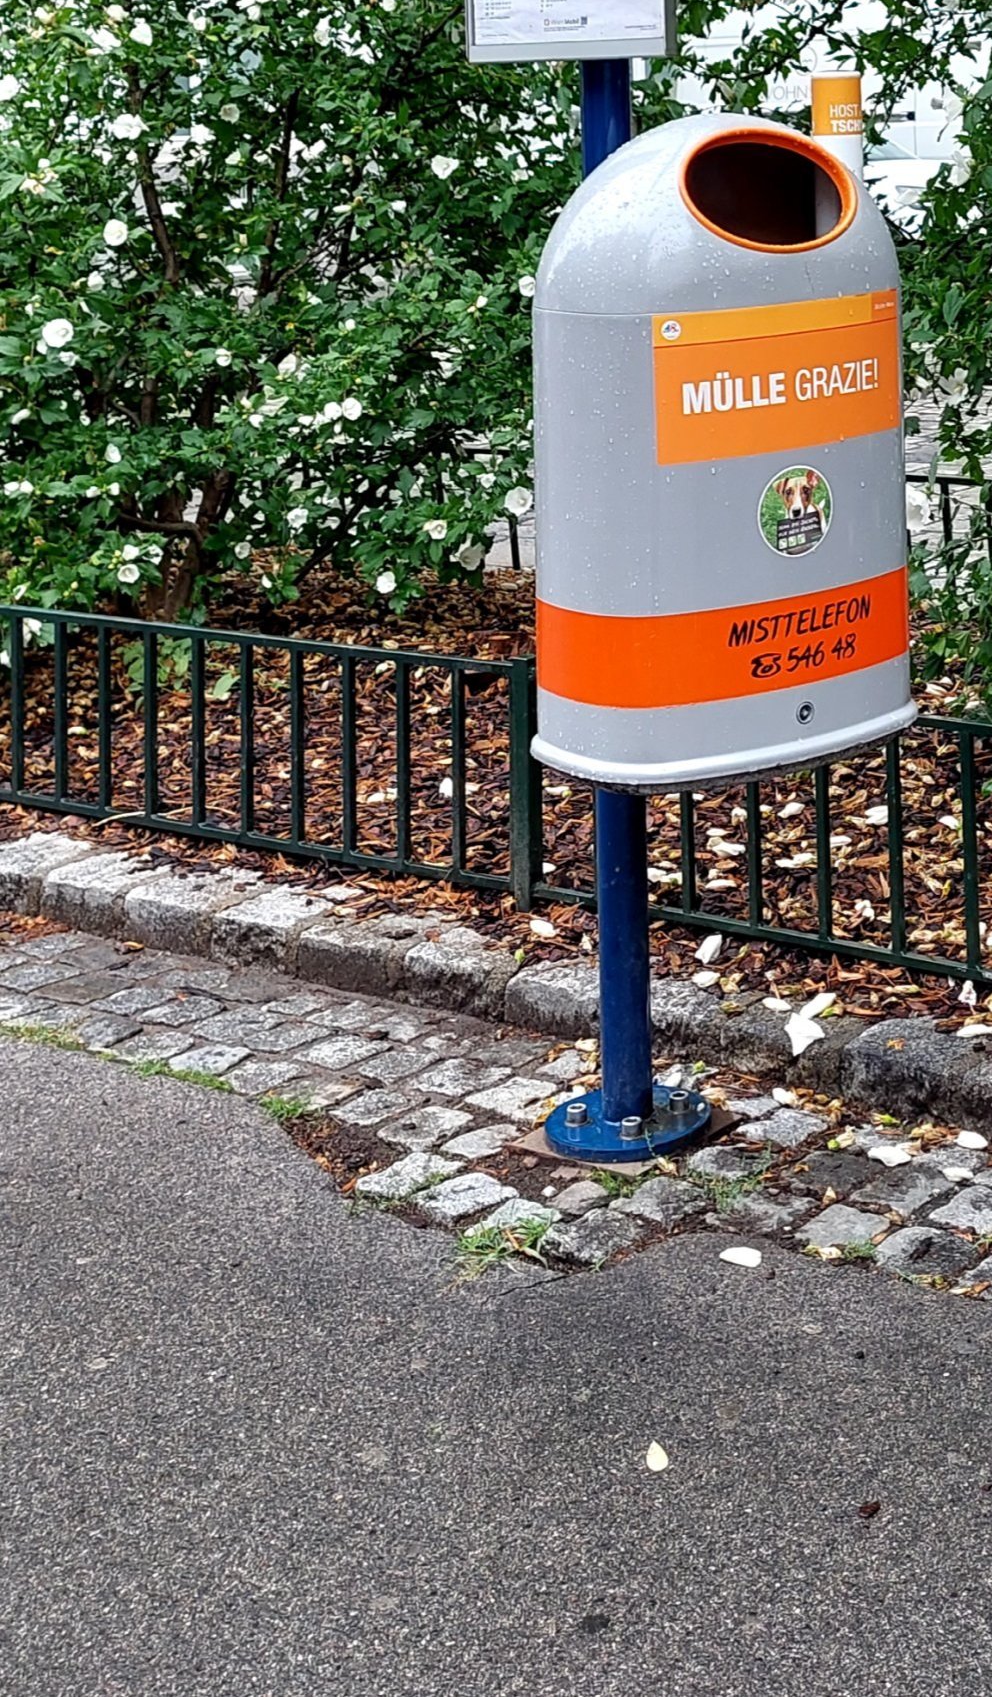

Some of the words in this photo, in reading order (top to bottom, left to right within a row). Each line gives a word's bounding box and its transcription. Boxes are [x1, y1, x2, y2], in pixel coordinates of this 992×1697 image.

[829, 103, 859, 118] HOST
[682, 371, 787, 415] MÜLLE
[795, 357, 879, 402] GRAZIE!
[728, 593, 872, 648] MISTTELEFON
[786, 640, 825, 673] 546
[831, 632, 857, 661] 48
